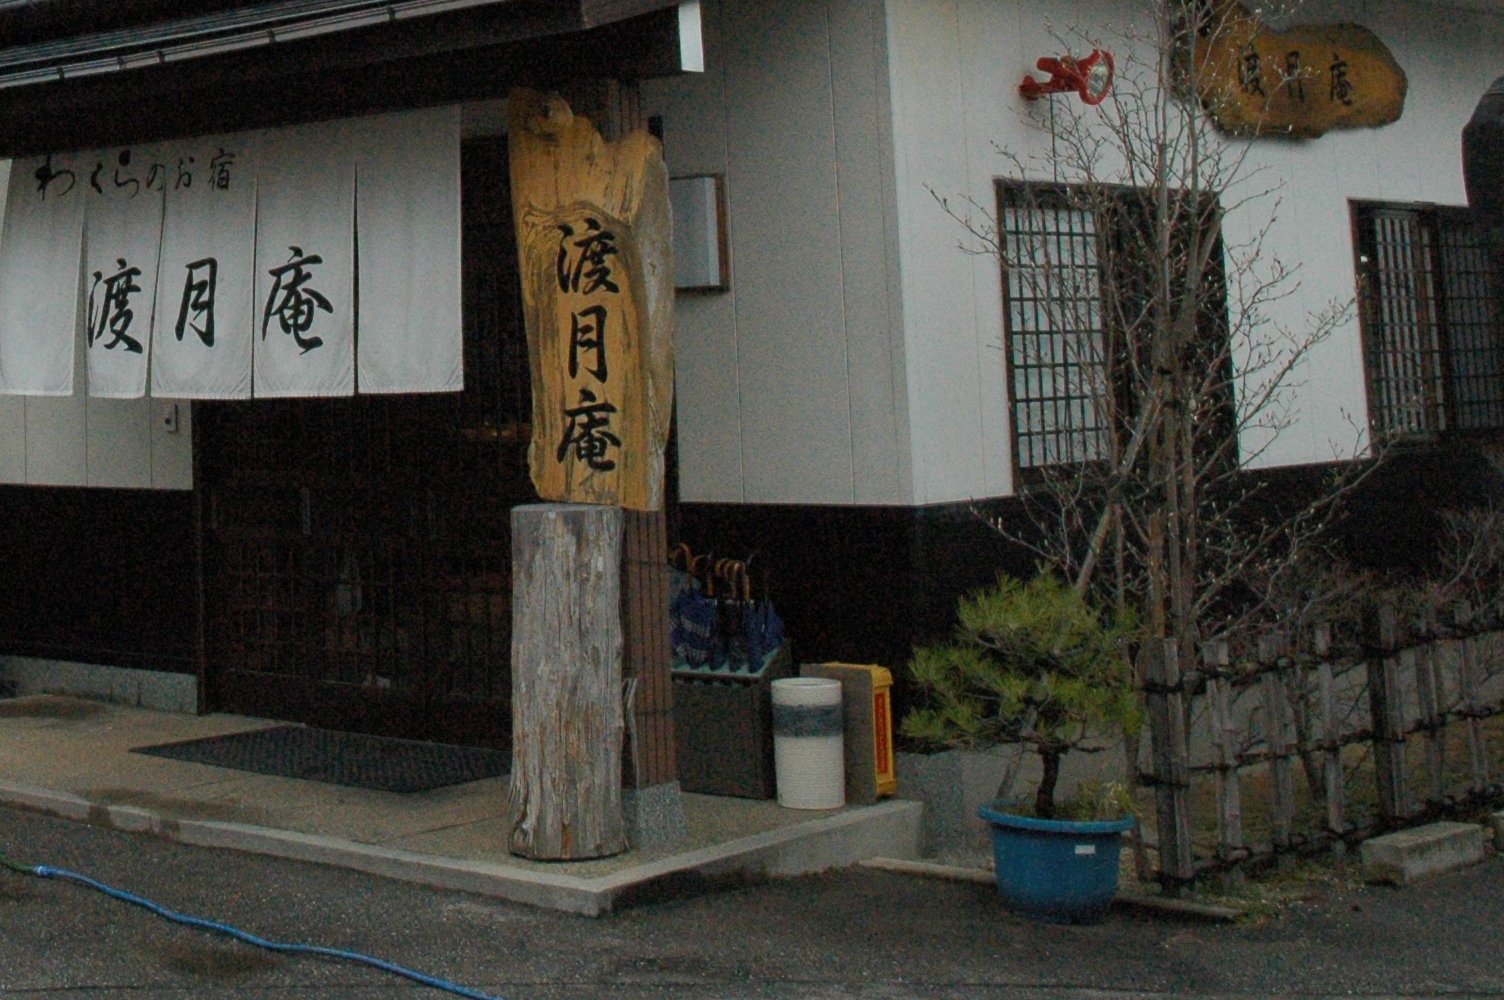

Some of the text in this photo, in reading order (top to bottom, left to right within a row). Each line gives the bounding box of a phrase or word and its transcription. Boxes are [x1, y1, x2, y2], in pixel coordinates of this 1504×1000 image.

[1236, 43, 1353, 106] 渡月庵
[36, 148, 236, 200] わくらのお宿
[88, 246, 334, 355] 渡月庵
[557, 218, 621, 471] 渡月庵
